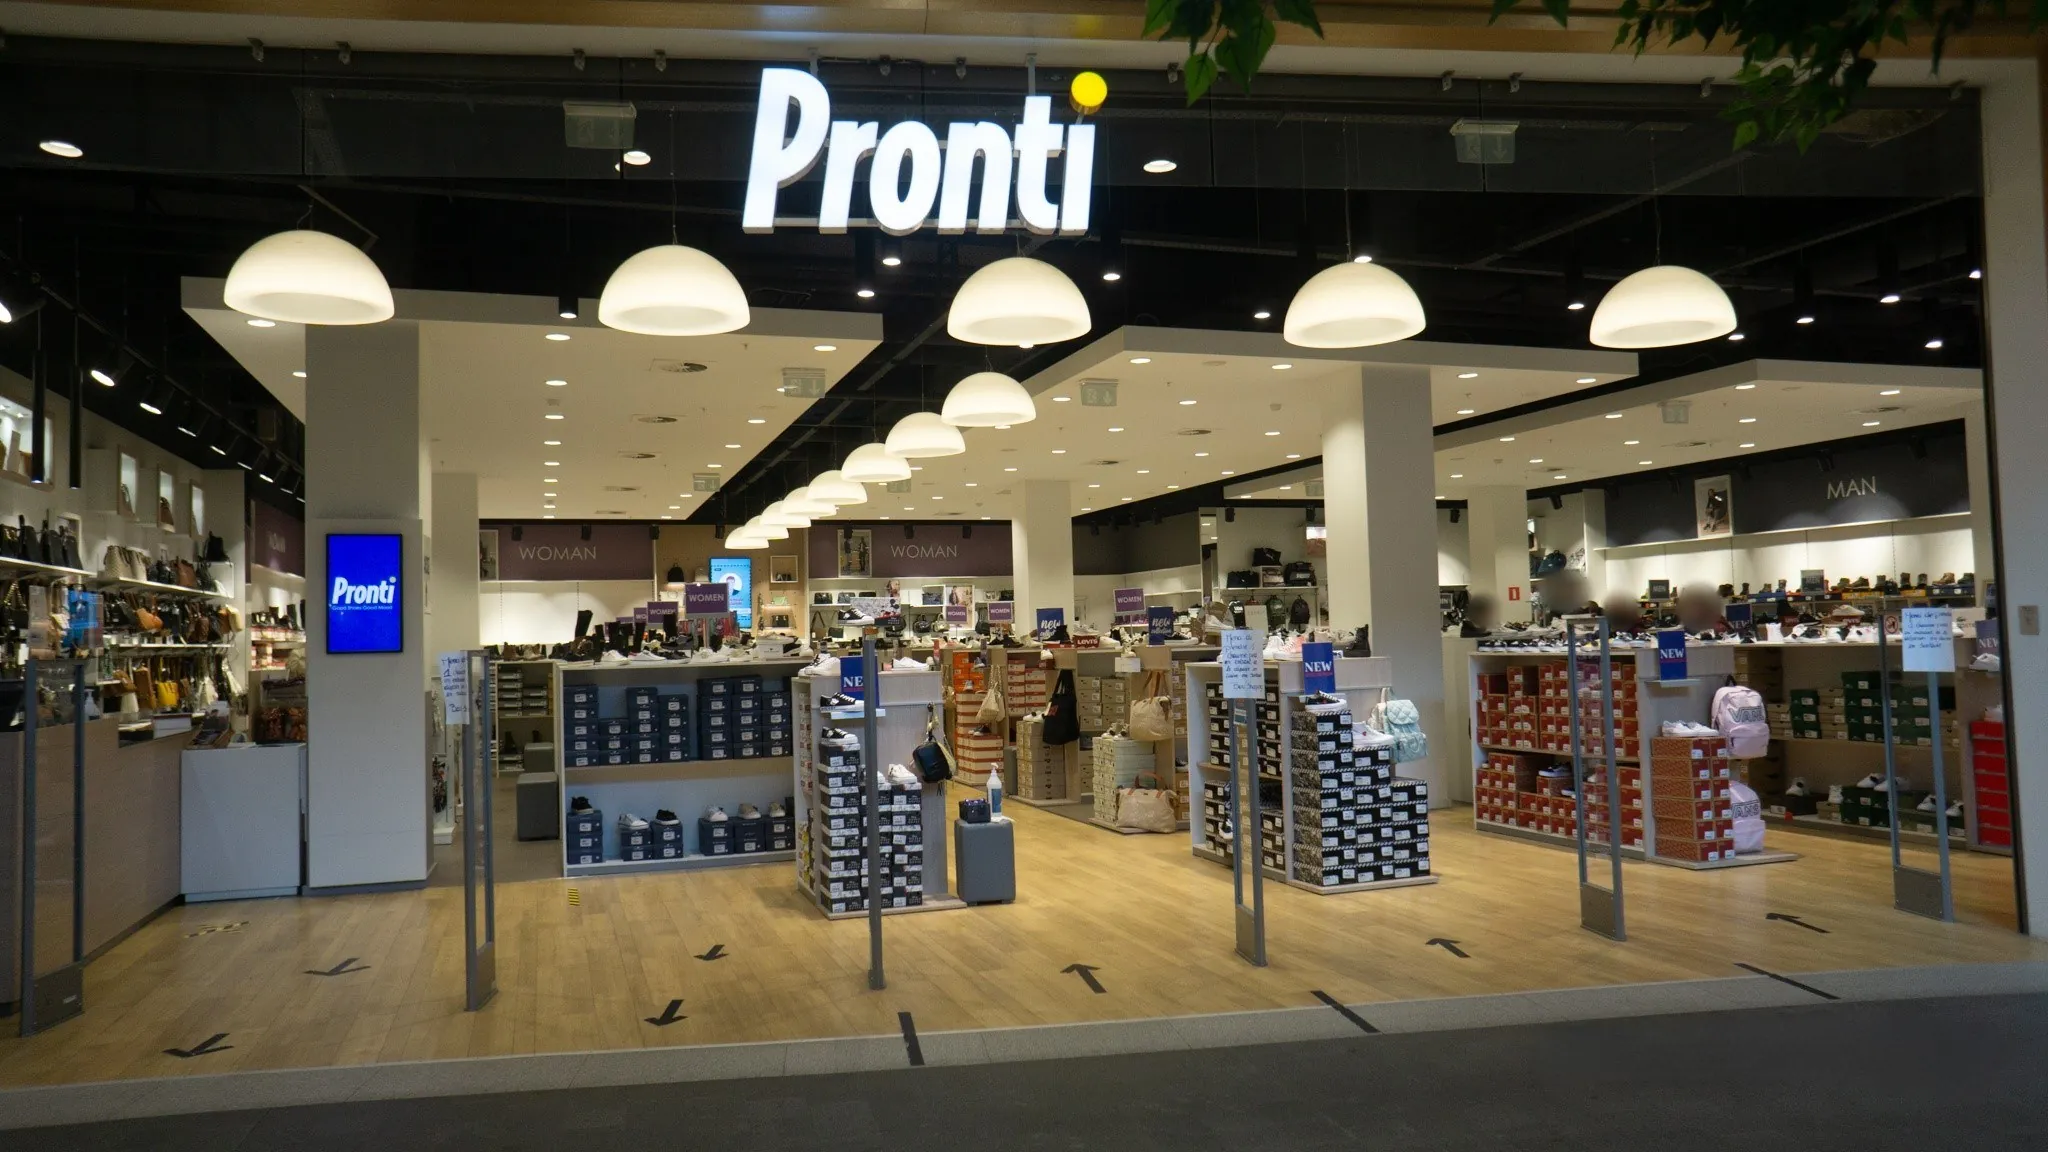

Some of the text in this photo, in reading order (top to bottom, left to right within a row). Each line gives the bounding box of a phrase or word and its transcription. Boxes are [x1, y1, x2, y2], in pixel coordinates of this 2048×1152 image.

[742, 67, 1108, 236] Pronti
[1827, 476, 1876, 499] MAN
[519, 546, 597, 560] WOMAN
[890, 545, 958, 558] WOMAN
[331, 576, 397, 604] Pronti
[688, 593, 725, 602] WOMEN
[1660, 648, 1684, 659] NEW
[1305, 661, 1332, 673] NEW
[843, 676, 864, 688] NE
